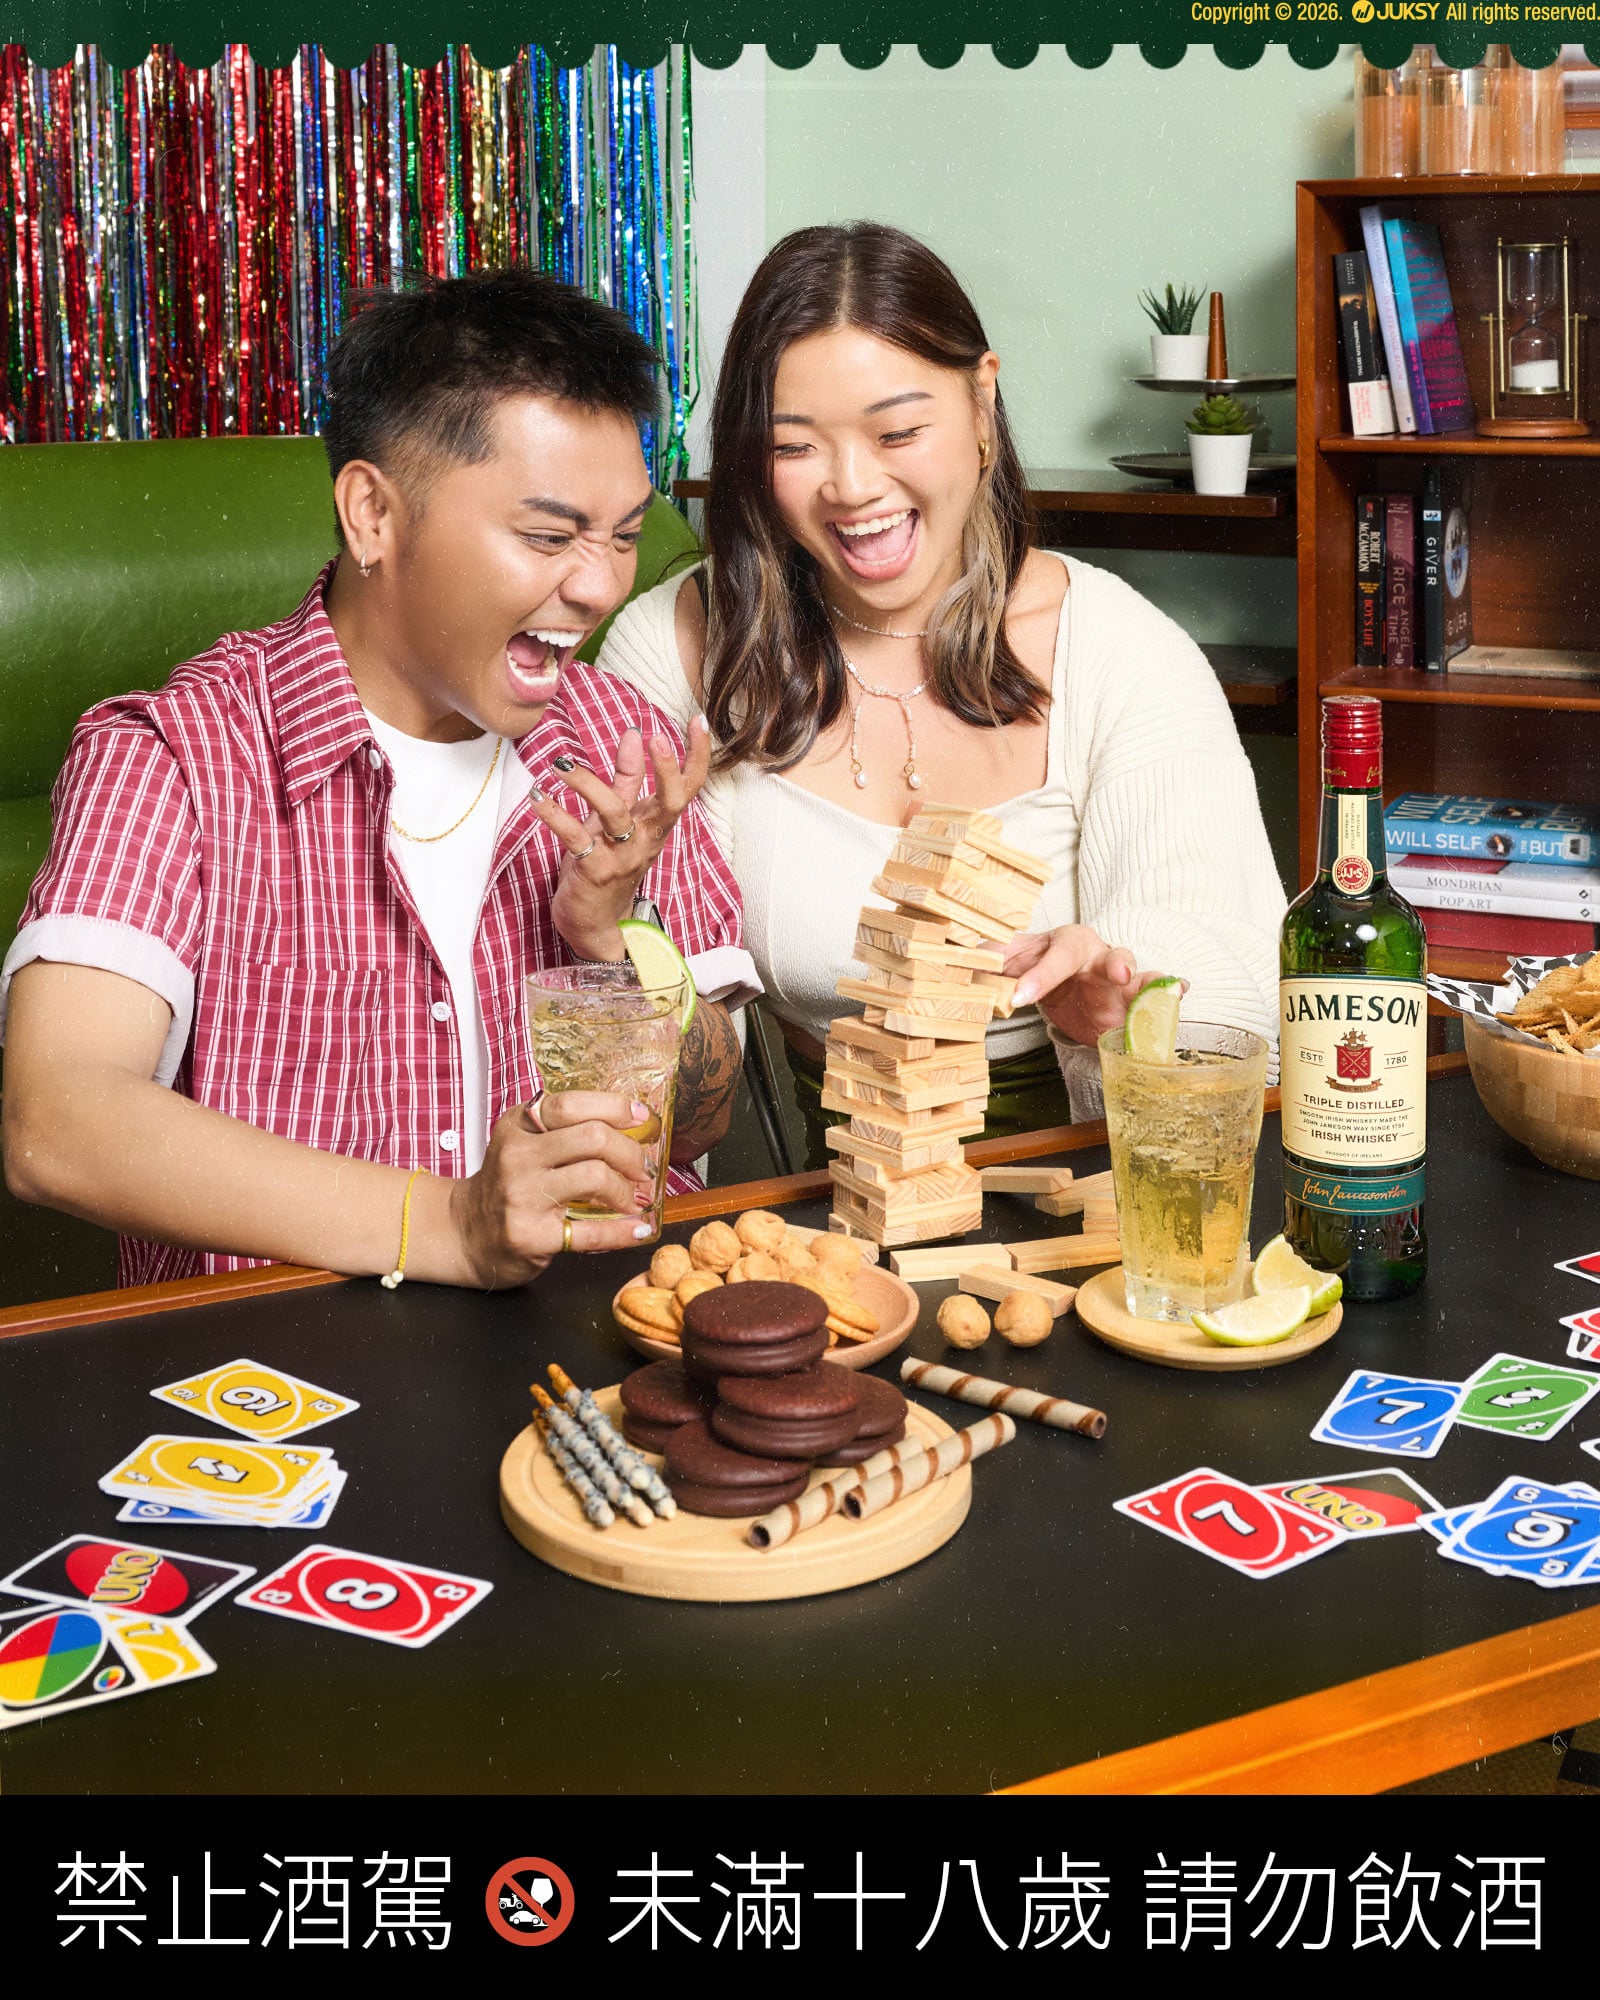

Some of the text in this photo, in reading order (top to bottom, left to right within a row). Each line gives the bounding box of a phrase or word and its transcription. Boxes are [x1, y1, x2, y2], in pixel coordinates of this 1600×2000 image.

[1359, 521, 1370, 572] McCAMMON
[1370, 531, 1381, 564] ROBERT
[1392, 516, 1404, 560] ANNE
[1425, 536, 1439, 586] GIVER
[1392, 566, 1406, 604] RICE
[1363, 628, 1374, 647] LIFE
[1389, 614, 1399, 643] TIME
[1400, 608, 1411, 650] ANGEL
[1388, 794, 1451, 820] WILL
[1386, 830, 1432, 848] WILL
[1436, 833, 1482, 850] SELF
[1427, 876, 1503, 892] MONDRIAN
[1439, 895, 1493, 910] POP ART
[1286, 994, 1420, 1027] JAMESON
[1385, 1055, 1407, 1066] 1780
[1303, 1094, 1405, 1110] TRIPLE DISTILLED
[1311, 1129, 1399, 1143] IRISH WHISKEY
[1320, 1122, 1352, 1131] JAMESON
[1302, 1178, 1329, 1199] John
[1365, 1376, 1386, 1389] 7
[1374, 1397, 1429, 1426] 7
[1132, 1499, 1162, 1516] 7
[1191, 1499, 1258, 1536] 7
[1281, 1483, 1386, 1532] UNO
[90, 1548, 164, 1605] UNO
[258, 1588, 294, 1606] 8
[324, 1577, 399, 1611] 8
[433, 1583, 468, 1602] 8
